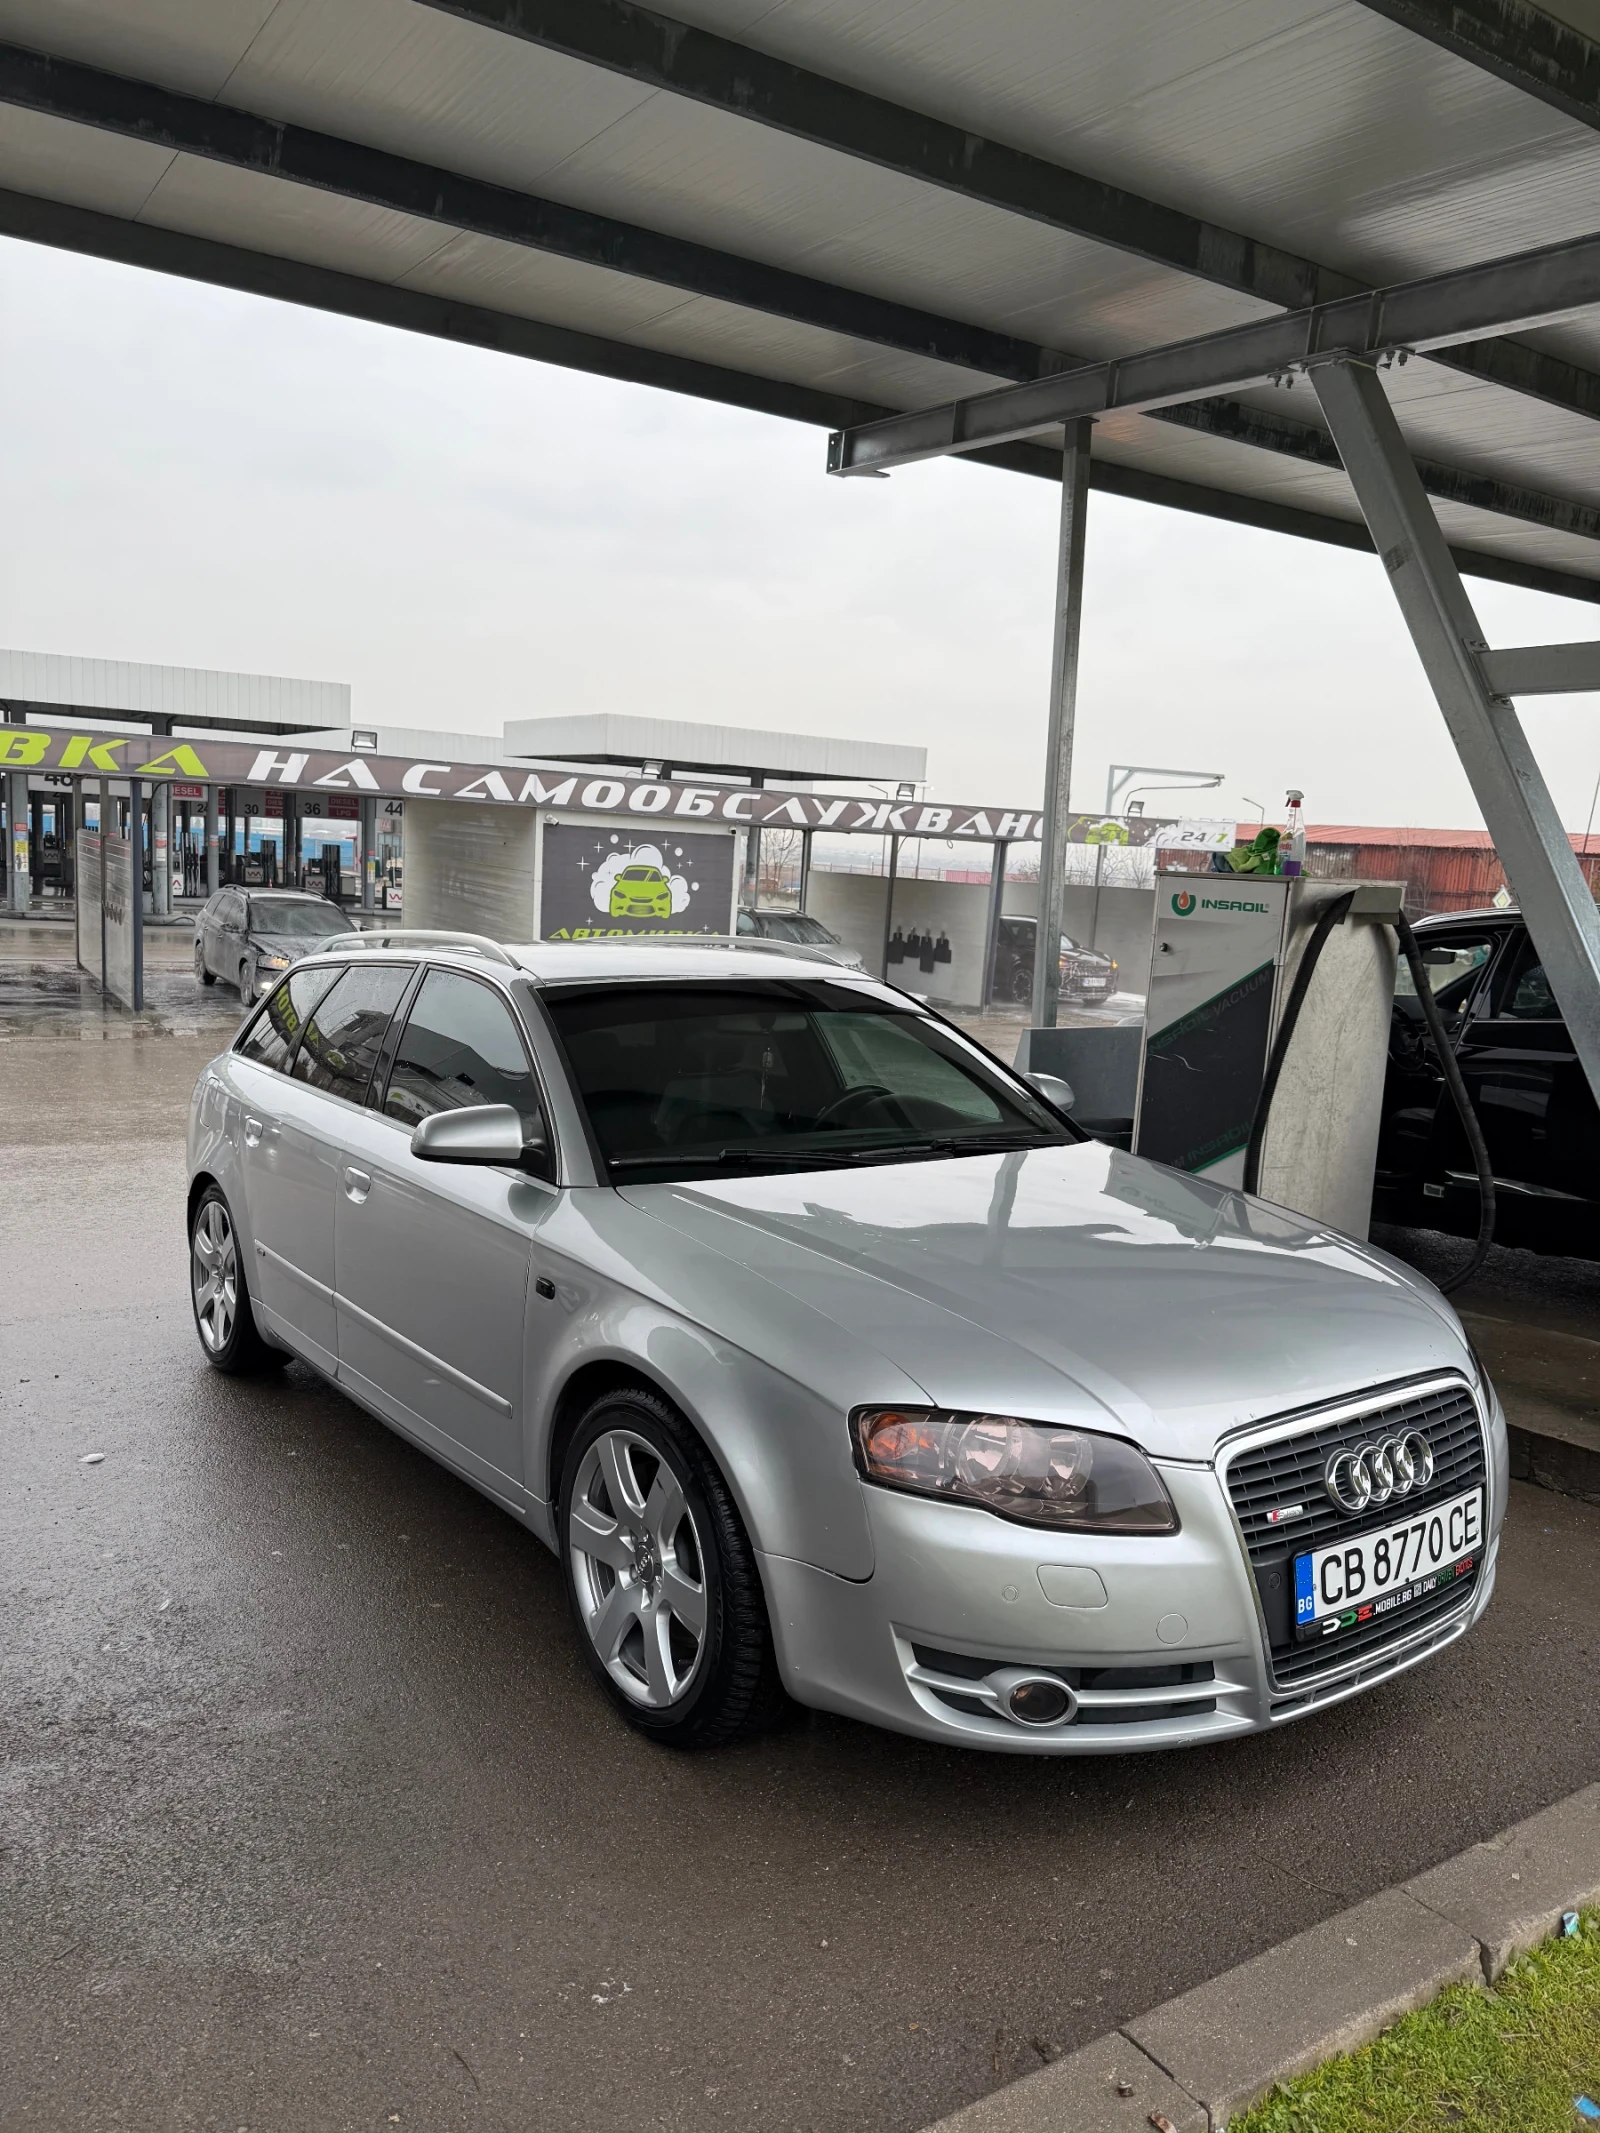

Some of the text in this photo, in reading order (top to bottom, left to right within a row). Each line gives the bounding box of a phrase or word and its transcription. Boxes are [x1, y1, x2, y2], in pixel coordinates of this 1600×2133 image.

[246, 751, 380, 789] НА
[174, 786, 200, 795] ESEL
[244, 803, 259, 815] 30
[304, 802, 321, 815] 36
[330, 797, 357, 806] DIESEL
[384, 801, 403, 816] 44
[1149, 969, 1273, 1055] NSAOIL VACUUM
[1320, 1497, 1478, 1606] CB 8770 CE
[1298, 1596, 1312, 1614] BG
